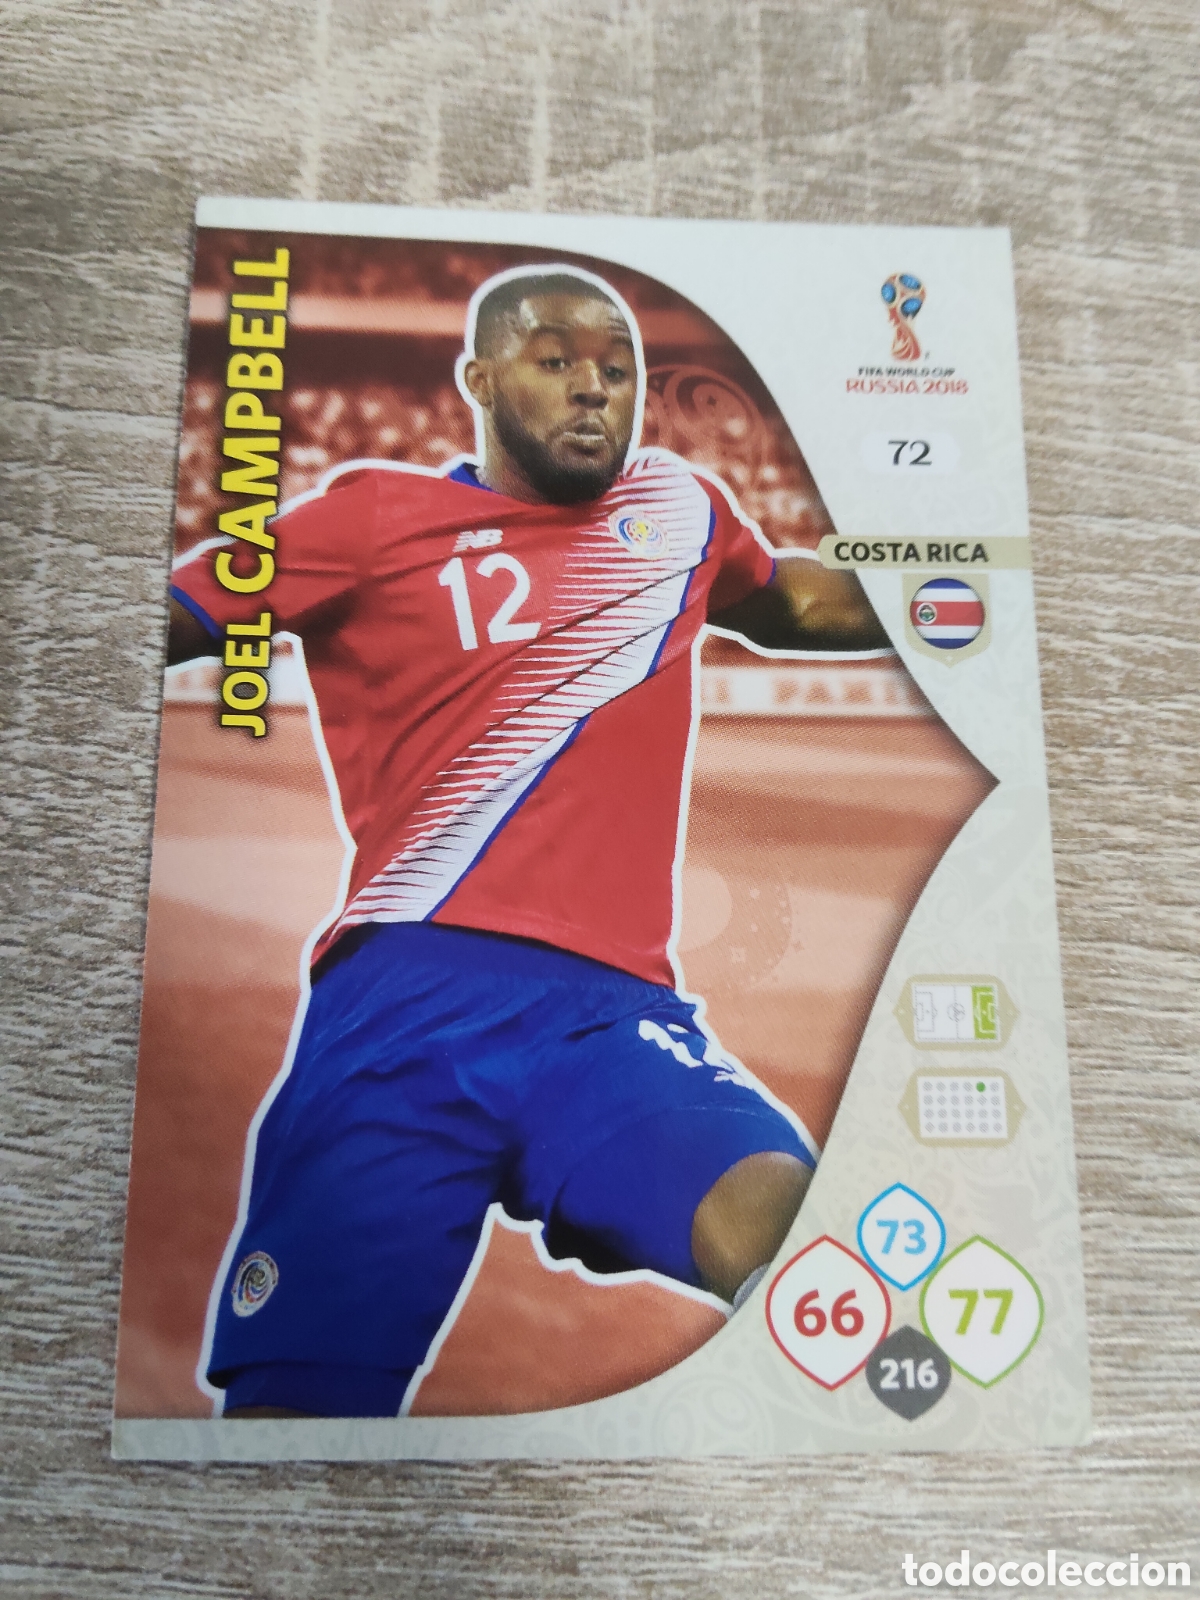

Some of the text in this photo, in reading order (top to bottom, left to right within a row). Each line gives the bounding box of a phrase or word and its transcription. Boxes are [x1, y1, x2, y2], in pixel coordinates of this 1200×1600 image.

[846, 379, 969, 395] RUSSIA 2018
[858, 366, 956, 378] FIFA WORLD CUP
[888, 439, 932, 466] 72
[215, 247, 290, 737] JOEL CAMPBELL
[834, 541, 989, 563] COSTA RICA
[437, 552, 542, 651] 12
[876, 1218, 927, 1256] 73
[793, 1288, 864, 1338] 66
[948, 1288, 1013, 1336] 77
[879, 1357, 938, 1390] 216
